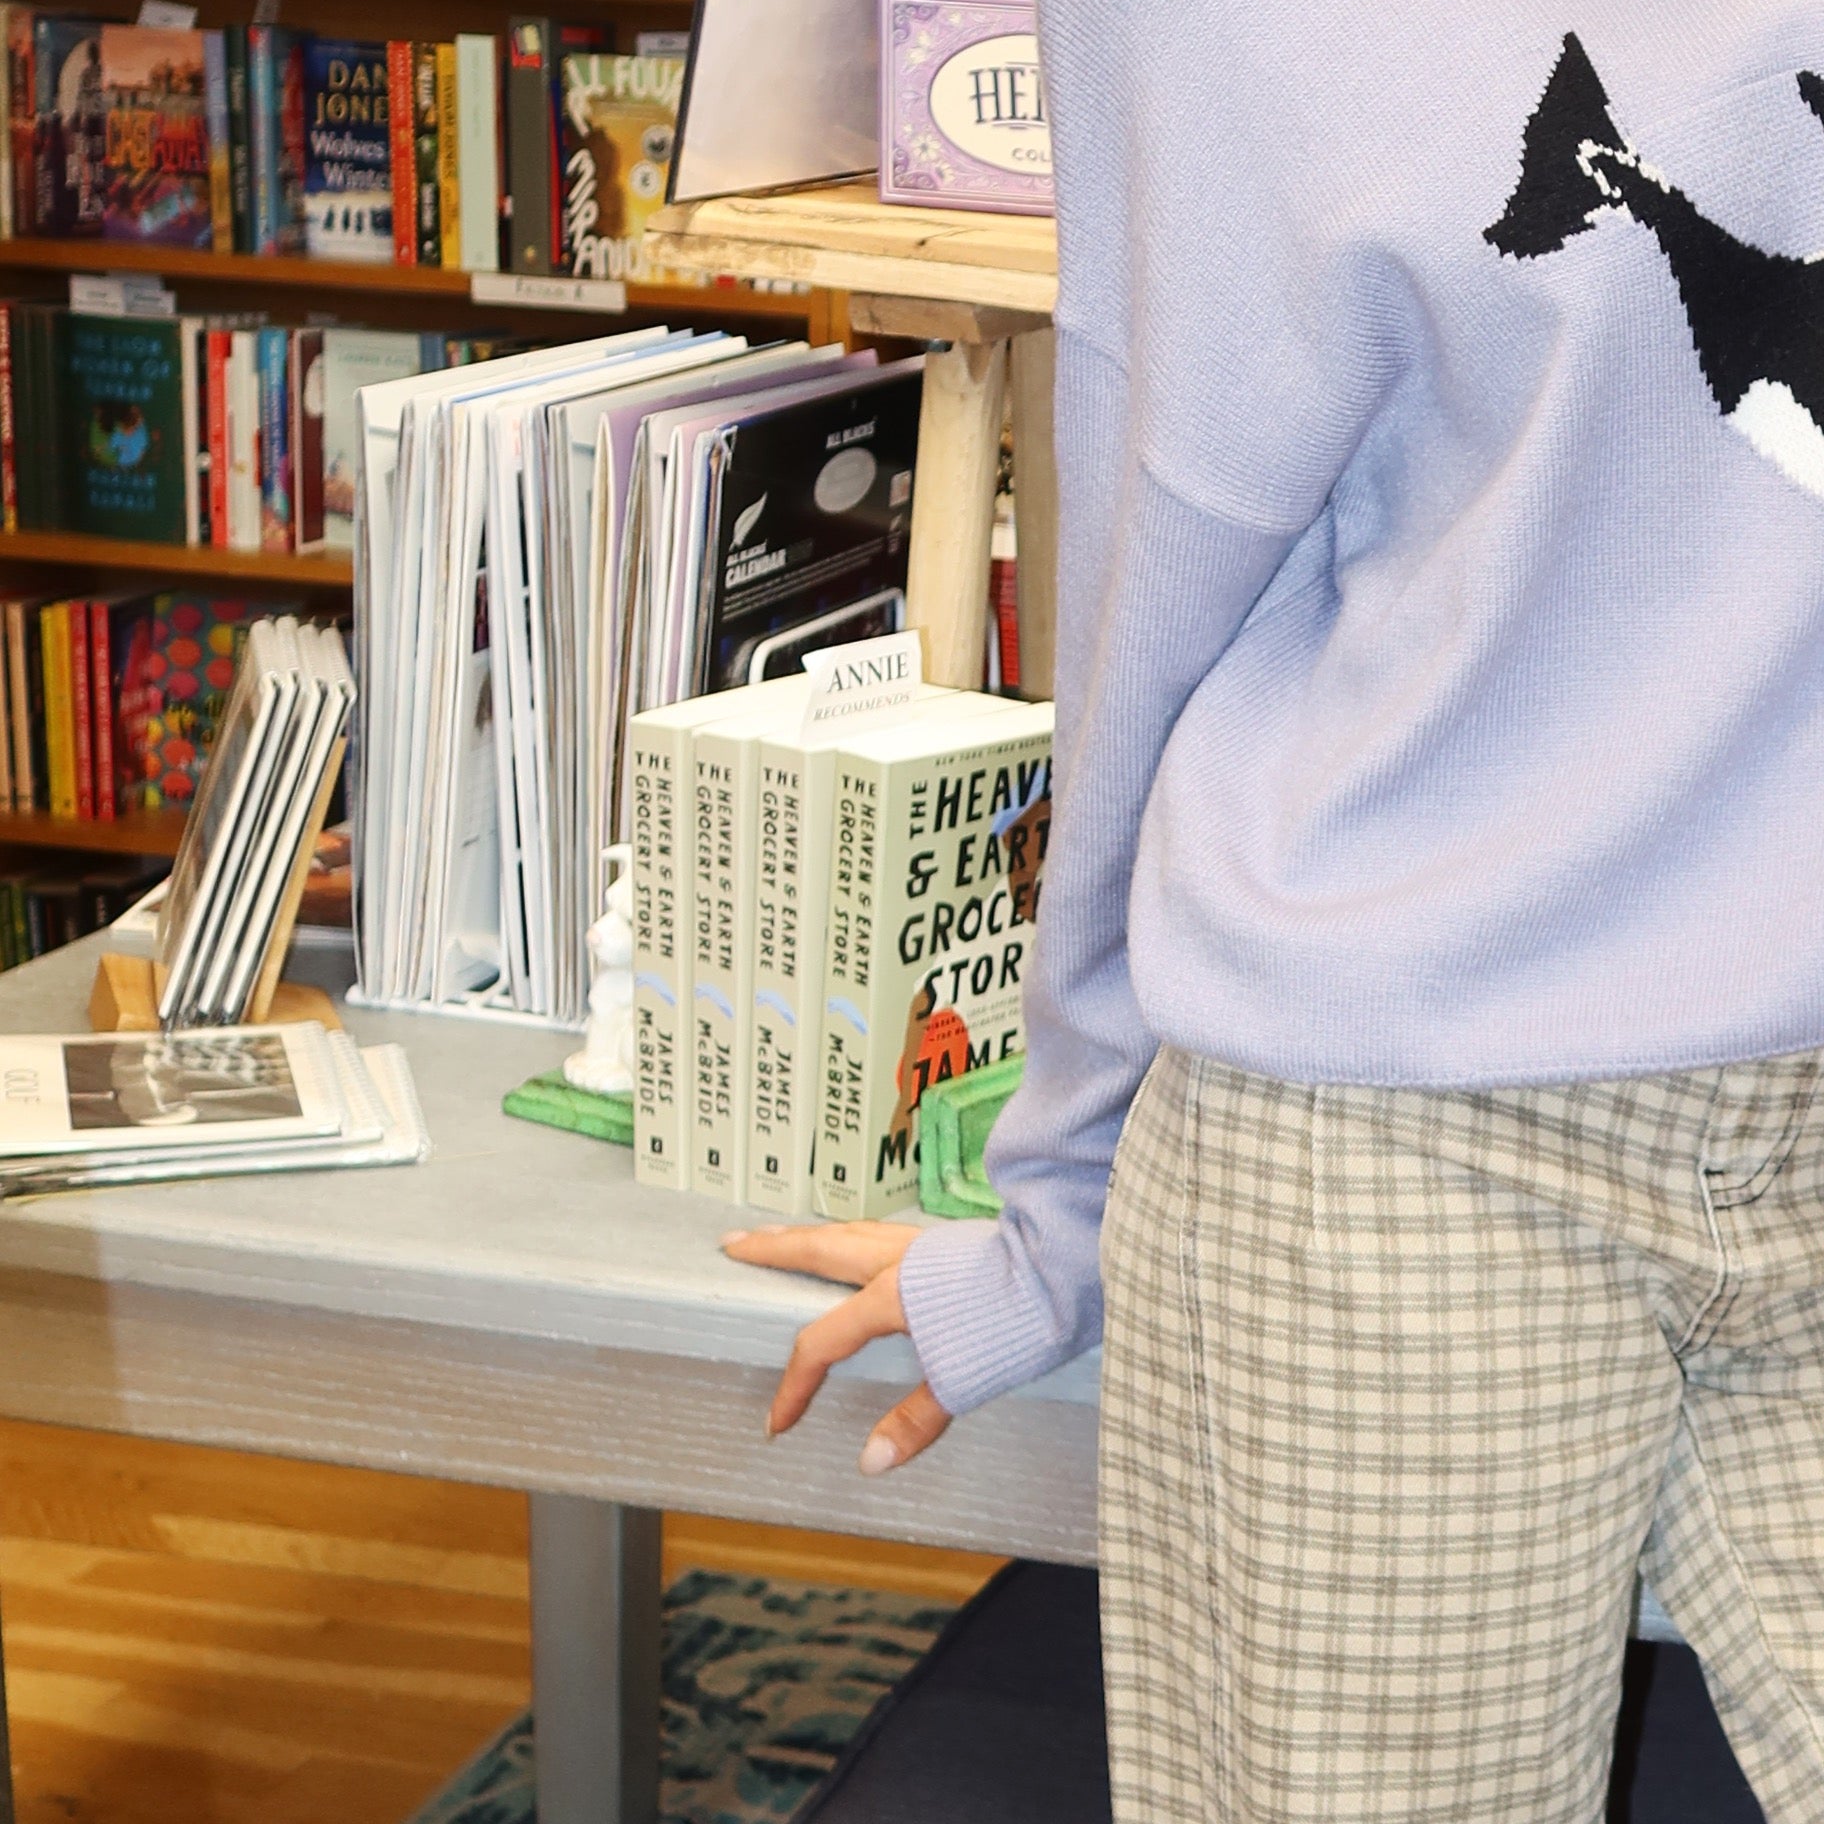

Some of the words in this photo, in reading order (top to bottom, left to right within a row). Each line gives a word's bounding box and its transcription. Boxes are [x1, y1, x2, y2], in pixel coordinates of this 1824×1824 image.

[310, 130, 385, 160] Wolves
[313, 92, 388, 127] JONE
[725, 548, 787, 589] CALENDAR
[814, 691, 914, 723] RECOMMENDS
[827, 652, 910, 694] ANNIE
[636, 751, 672, 771] THE
[697, 762, 733, 782] THE
[765, 767, 799, 788] THE
[842, 775, 877, 797] THE
[635, 773, 652, 872] GROCERY
[656, 776, 673, 858] HEAVEN
[696, 784, 713, 882] GROCERY
[716, 788, 733, 869] HEAVEN
[760, 790, 778, 889] GROCERY
[782, 793, 800, 875] HEAVEN
[859, 803, 876, 884] HEAVEN
[909, 780, 928, 840] THE
[838, 798, 856, 899] GROCERY
[906, 849, 939, 899] &
[637, 884, 653, 953] STORE
[657, 888, 674, 959] EARTH
[696, 897, 713, 962] STORE
[717, 899, 733, 973] EARTH
[760, 900, 776, 971] STORE
[781, 905, 797, 979] EARTH
[834, 907, 850, 979] STORE
[856, 914, 872, 988] EARTH
[915, 941, 1023, 1022] STOR
[638, 1006, 655, 1117] McBRIDE
[657, 1032, 674, 1105] JAMES
[696, 1018, 713, 1129] McBRIDE
[714, 1043, 731, 1118] JAMES
[756, 1025, 773, 1137] McBRIDE
[774, 1049, 792, 1125] JAMES
[824, 1033, 844, 1146] McBRIDE
[845, 1058, 863, 1136] JAMES
[908, 1028, 1018, 1114] JAME
